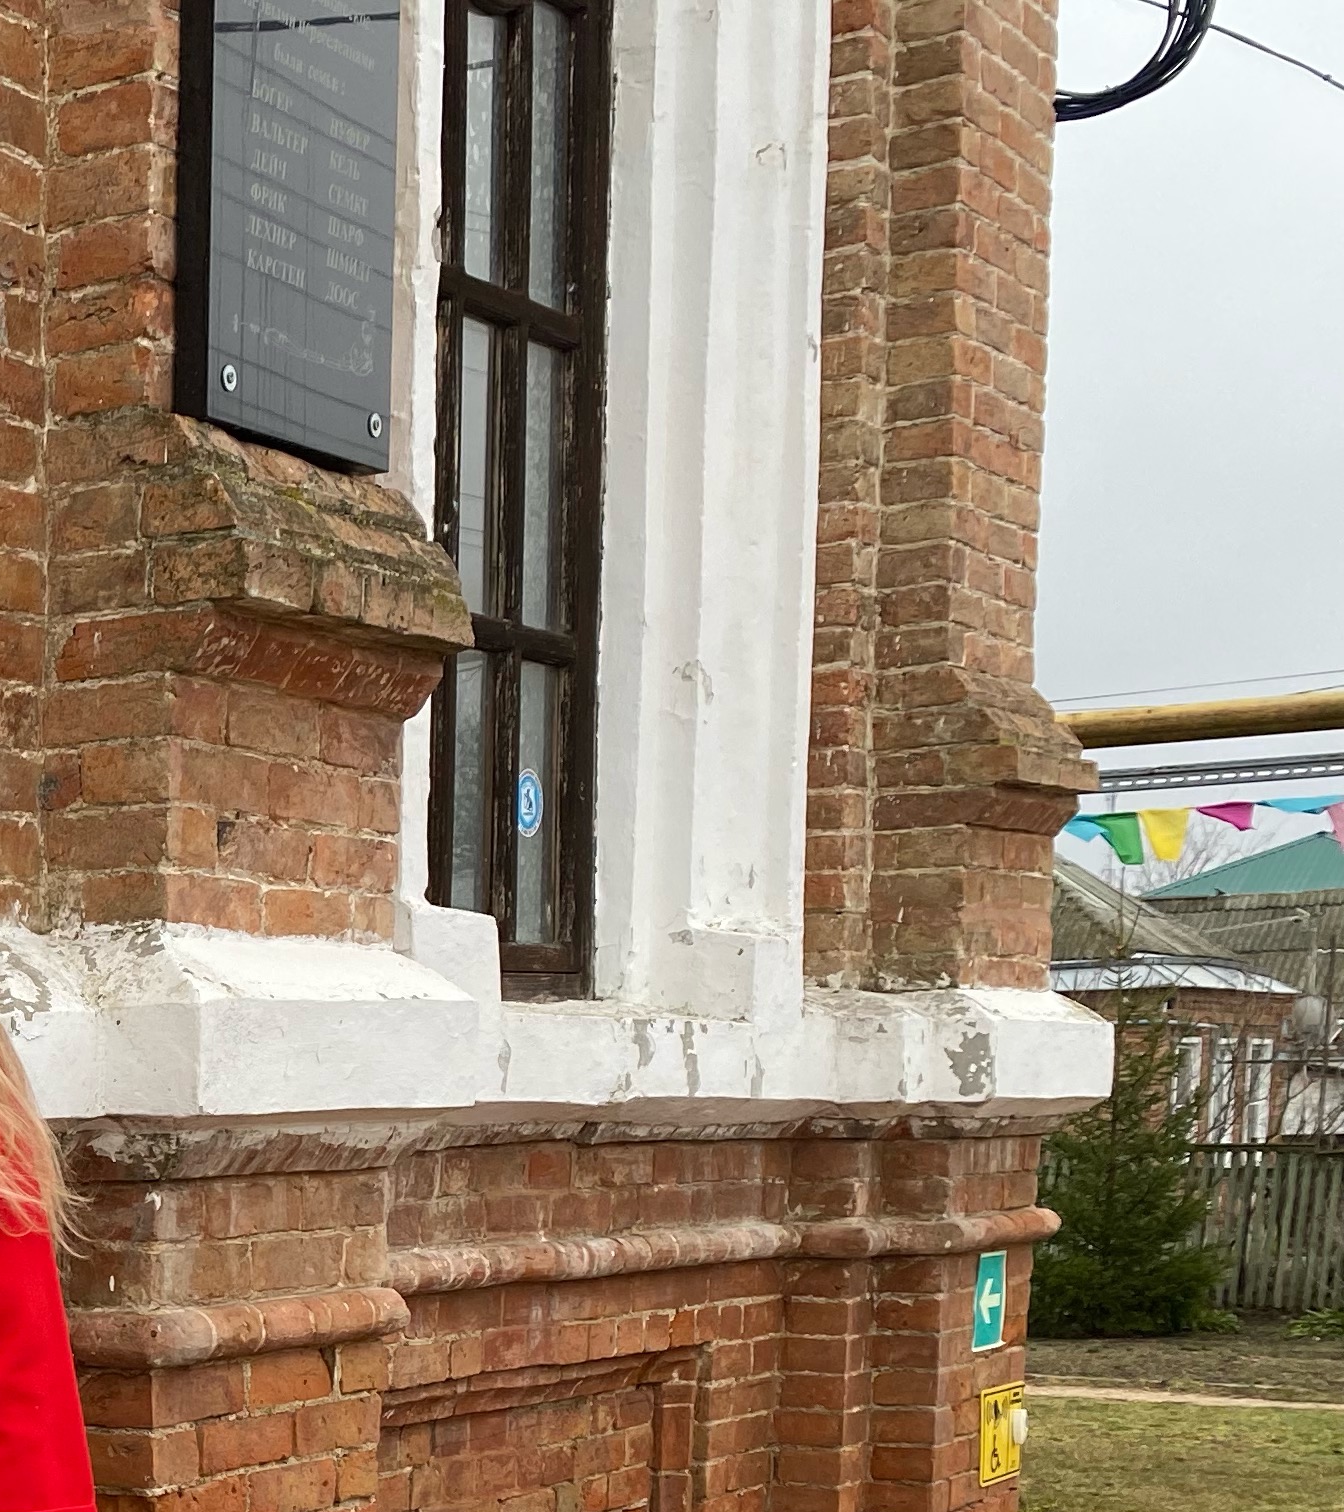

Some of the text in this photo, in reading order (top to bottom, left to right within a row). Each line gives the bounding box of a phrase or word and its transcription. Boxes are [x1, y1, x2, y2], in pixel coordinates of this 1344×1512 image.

[251, 113, 309, 154] ВАЛЬТЕР
[250, 149, 288, 180] ДЕЙЧ
[329, 150, 360, 181] КЕЛЬ
[250, 182, 288, 214] ФРИК
[245, 215, 297, 250] ЛЕХНЕР
[328, 215, 365, 247] ШАРФ
[247, 248, 306, 289] КАРСТЕН
[325, 281, 359, 310] ДООС
